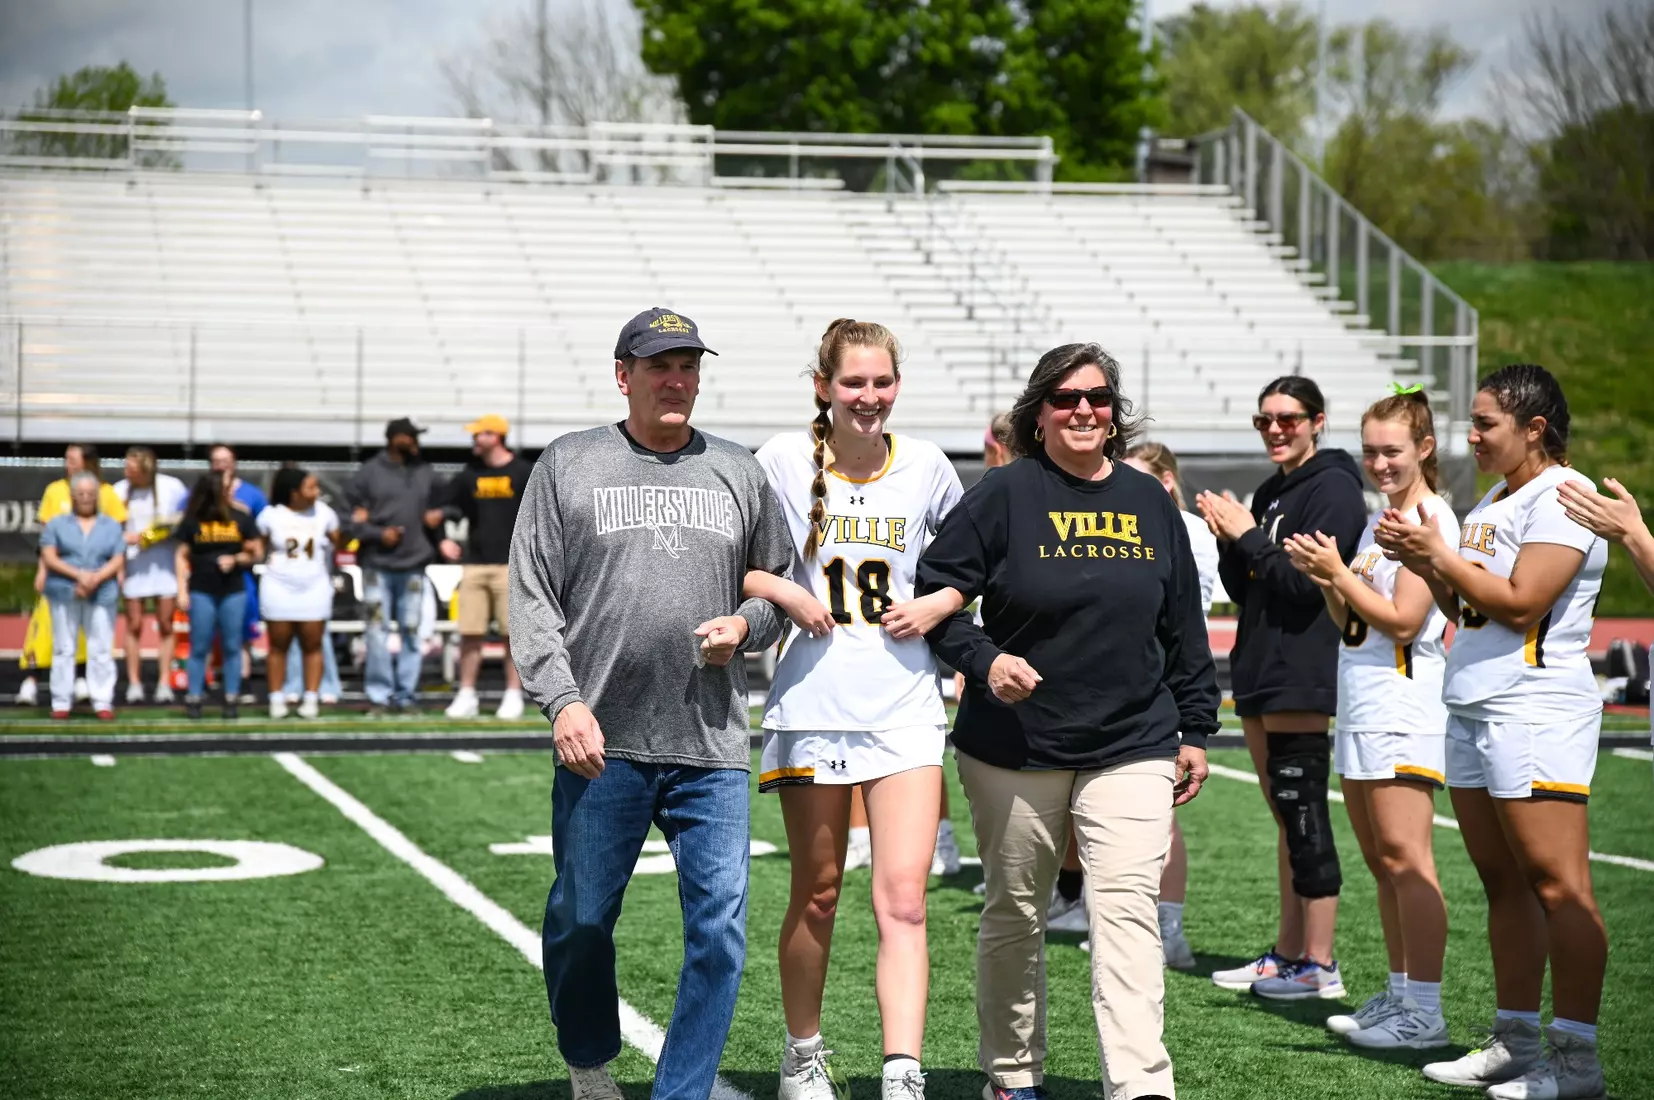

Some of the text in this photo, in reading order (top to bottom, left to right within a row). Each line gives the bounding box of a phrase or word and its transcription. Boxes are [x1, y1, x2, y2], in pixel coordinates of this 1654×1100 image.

[593, 485, 734, 540] MILLERSVILLE
[1048, 511, 1142, 545] VILLE
[286, 537, 315, 561] 24
[1038, 544, 1156, 560] LACROSSE
[1459, 522, 1497, 557] LLE
[822, 555, 893, 626] 18
